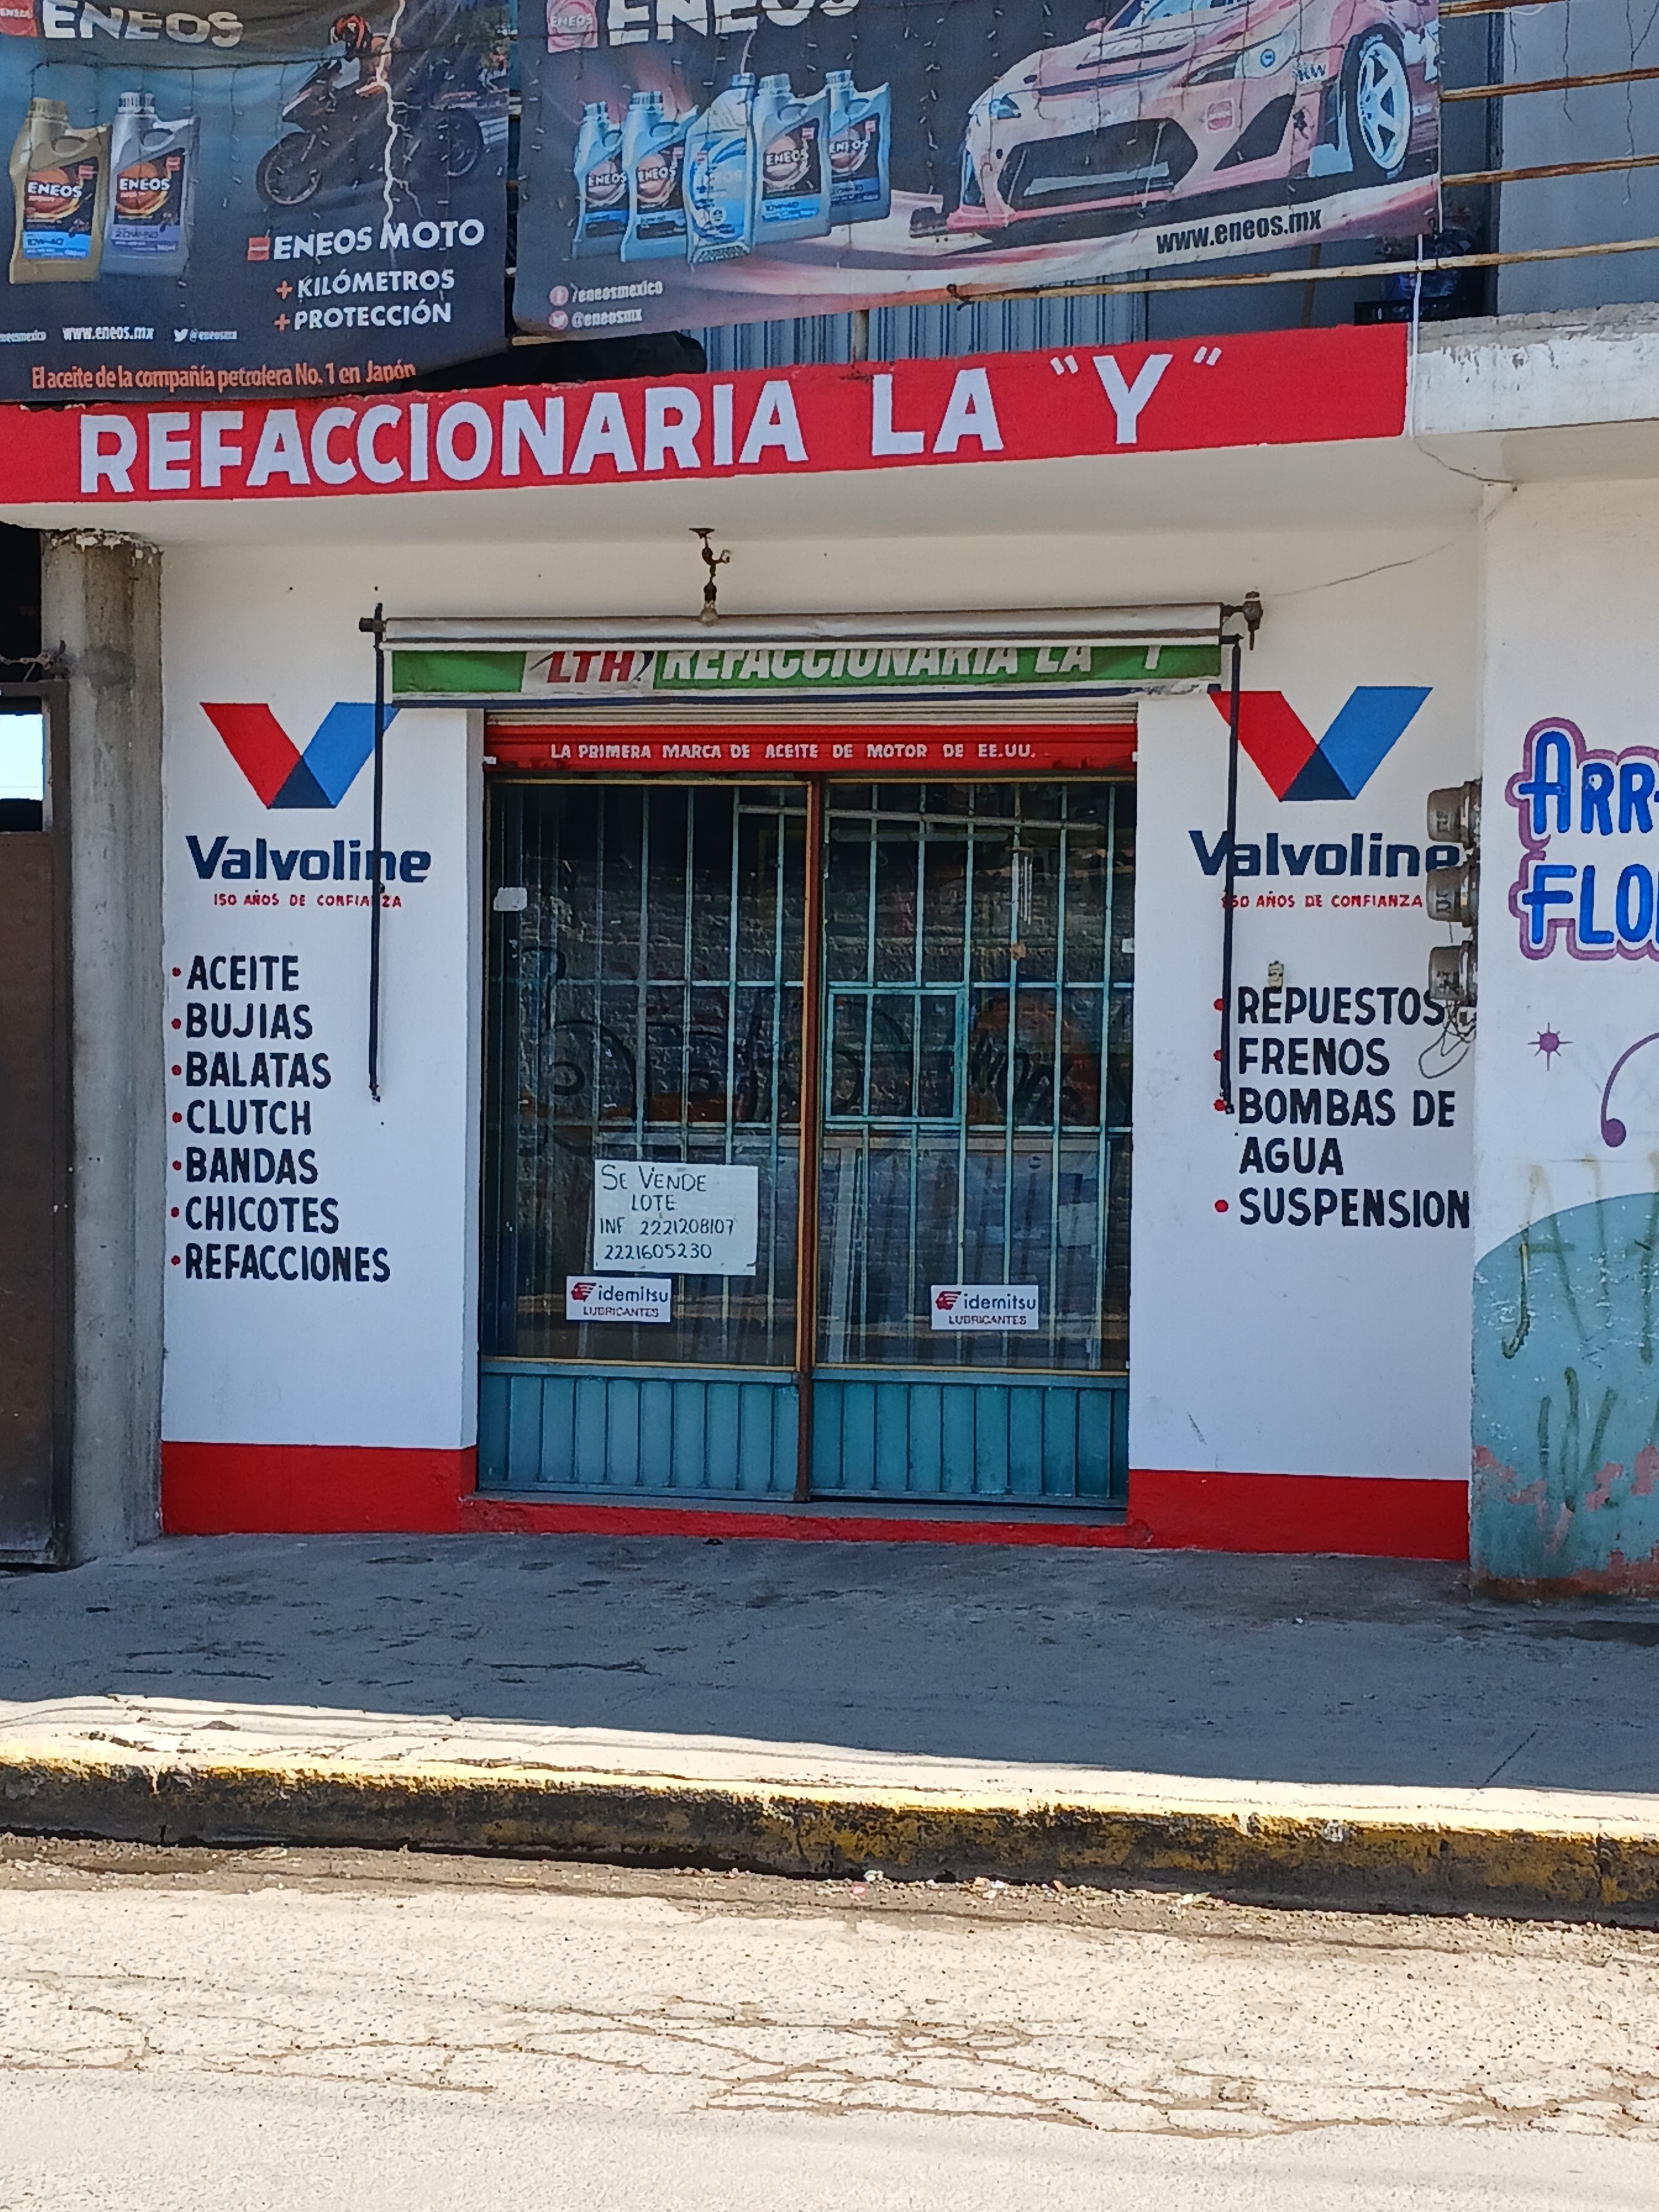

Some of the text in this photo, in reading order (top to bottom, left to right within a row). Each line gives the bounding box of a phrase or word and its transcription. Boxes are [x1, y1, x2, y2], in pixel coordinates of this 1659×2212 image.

[42, 0, 243, 48] ENEOS
[766, 149, 809, 165] ENEOS
[28, 181, 82, 198] ENEOS
[119, 178, 170, 191] ENEOS
[273, 219, 485, 260] ENEOS MOTO
[1156, 209, 1322, 254] www.eneos.mx
[298, 268, 455, 298] KILÓMETROS
[294, 298, 451, 330] PROTECCIÓN
[62, 326, 155, 341] www.eneos.mx
[31, 359, 416, 394] El aceite de la compañía petrolera No. 1 en Japón
[80, 379, 809, 494] REFACCIONARIA
[871, 367, 1004, 456] LA
[546, 650, 635, 683] LTH
[551, 744, 571, 758] LA
[663, 744, 722, 758] MARCA
[730, 744, 750, 758] DE
[765, 743, 819, 759] ACEITE
[832, 743, 853, 758] DE
[867, 743, 927, 758] MOTOR
[943, 743, 963, 757] DE
[1519, 731, 1659, 836] ARR
[185, 835, 432, 883] Valvoline
[1188, 830, 1461, 878] Valvoline
[214, 893, 237, 906] 150
[289, 894, 305, 906] DE
[317, 894, 402, 908] CONFIAZA
[1305, 894, 1323, 908] DE
[1330, 894, 1423, 908] CONFIANZA
[1522, 863, 1659, 944] FLO
[187, 955, 299, 992] ACEITE
[185, 1002, 313, 1040] BUJIAS
[1237, 986, 1445, 1026] REPUESTOS
[185, 1051, 331, 1089] BALATAS
[1239, 1037, 1390, 1076] FRENOS
[186, 1099, 311, 1135] CLUTCH
[1238, 1087, 1455, 1128] BOMBAS DE
[186, 1146, 319, 1185] BANDAS
[1239, 1136, 1344, 1175] AGUA
[639, 1165, 707, 1192] VENDE
[185, 1195, 339, 1234] CHICOTES
[632, 1194, 678, 1211] LOTE
[1239, 1187, 1470, 1229] SUSPENSION
[600, 1217, 735, 1236] INF 2221208107
[185, 1243, 391, 1283] REFACCIONES
[604, 1244, 712, 1261] 2221605230
[598, 1285, 668, 1303] idemitsu
[963, 1293, 1036, 1310] idemitsu
[583, 1307, 659, 1318] LUBRICANTES
[948, 1315, 1027, 1325] LUBRICANTES
